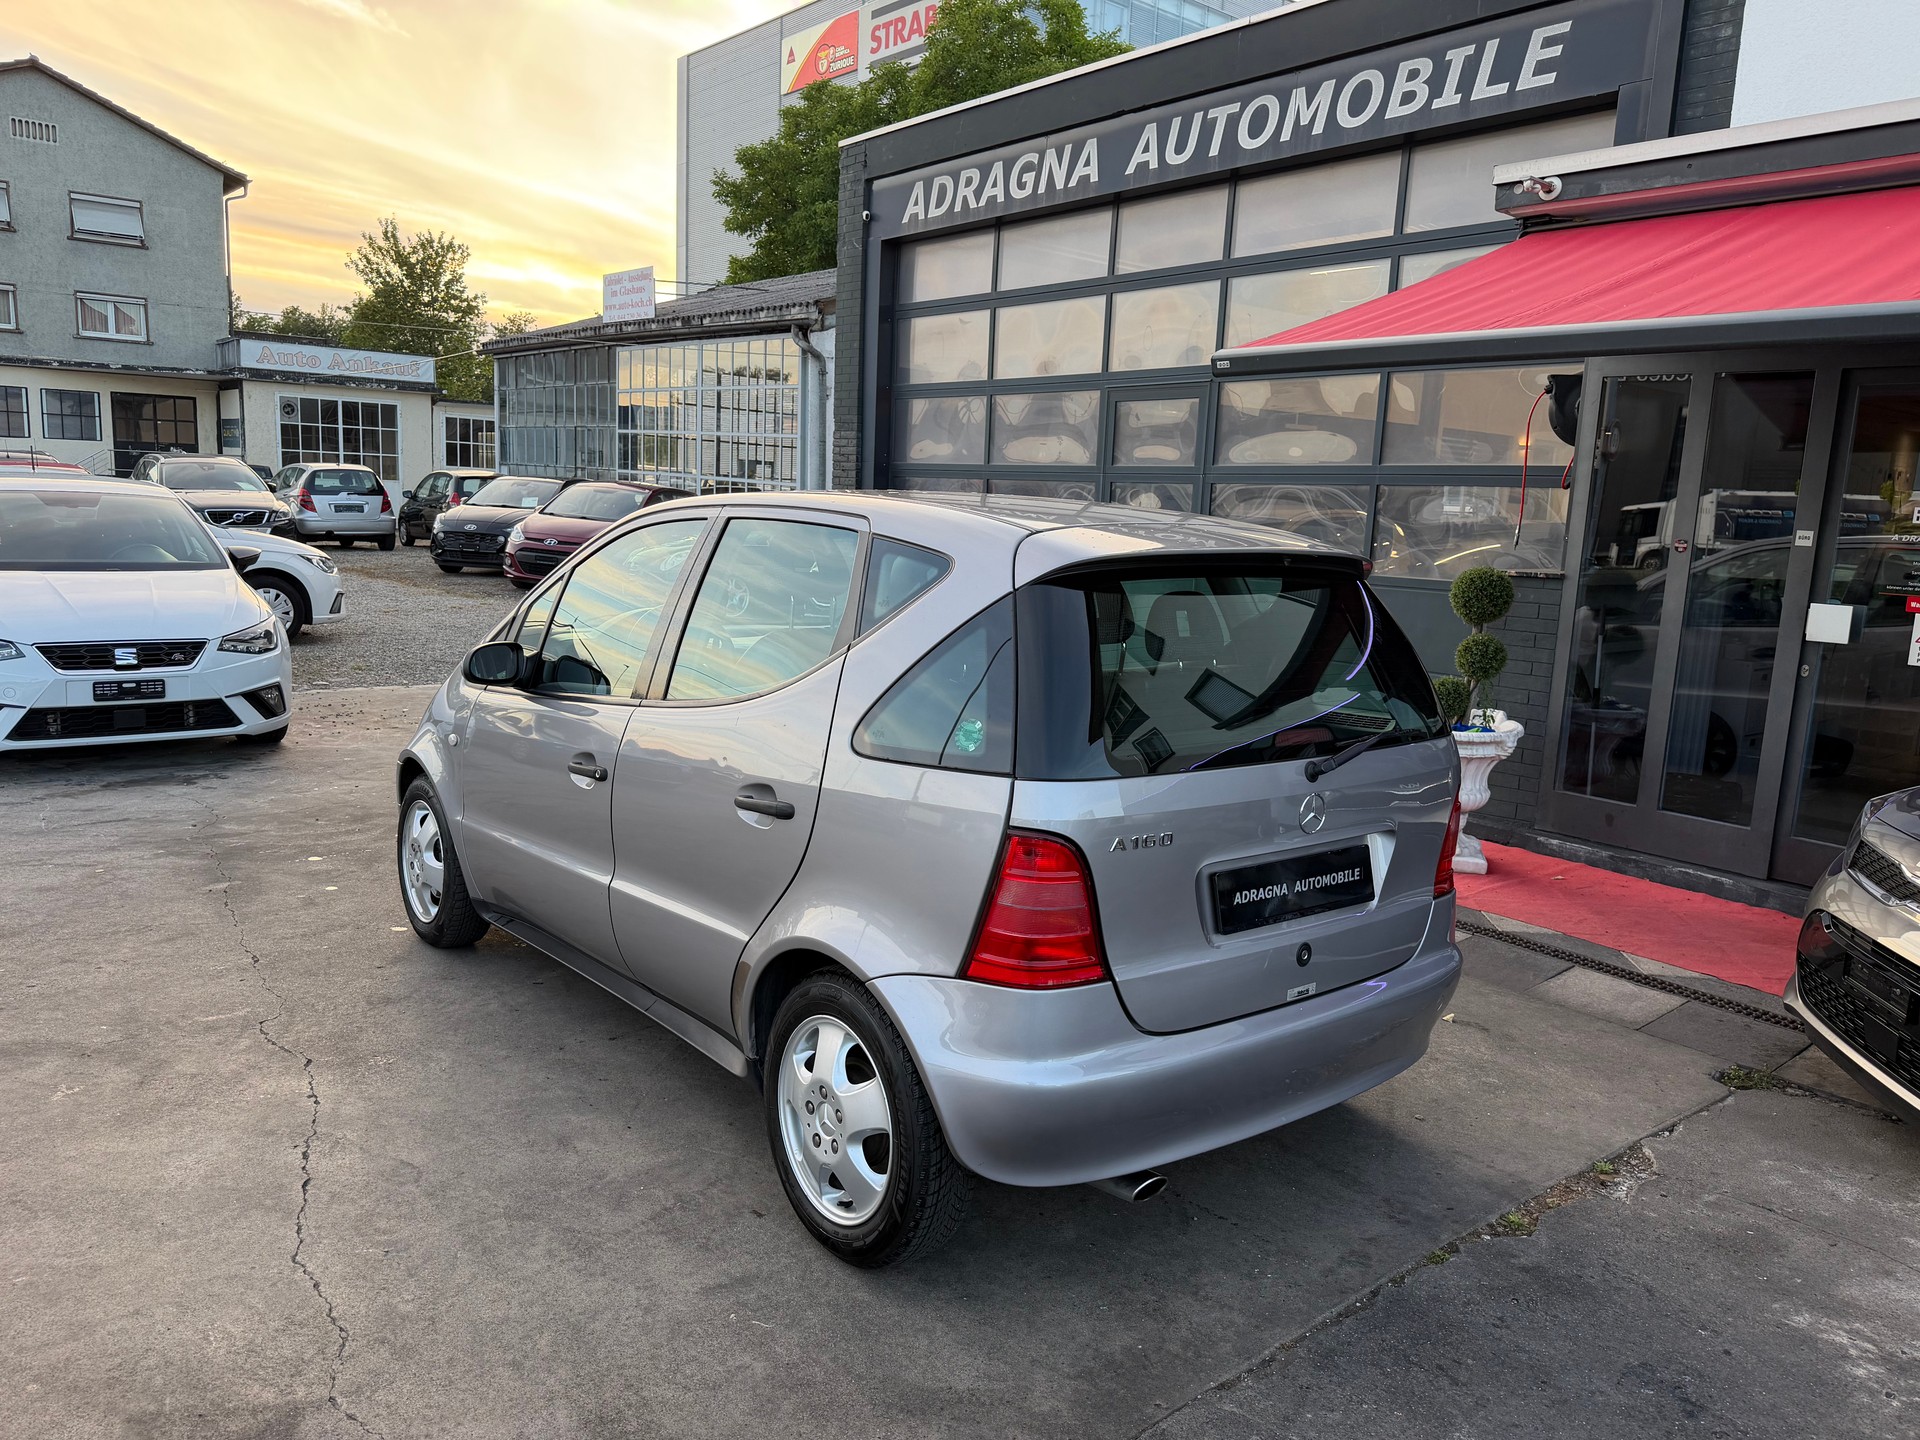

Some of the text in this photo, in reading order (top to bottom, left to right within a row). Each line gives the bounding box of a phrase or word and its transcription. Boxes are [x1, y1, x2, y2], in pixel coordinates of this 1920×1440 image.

[901, 20, 1573, 224] ADRAGNA AUTOMOBILE
[611, 285, 645, 297] im Glashaus
[256, 345, 421, 378] Auto Ankauf
[1233, 867, 1361, 905] ADRAGNA AUTOMOBILE
